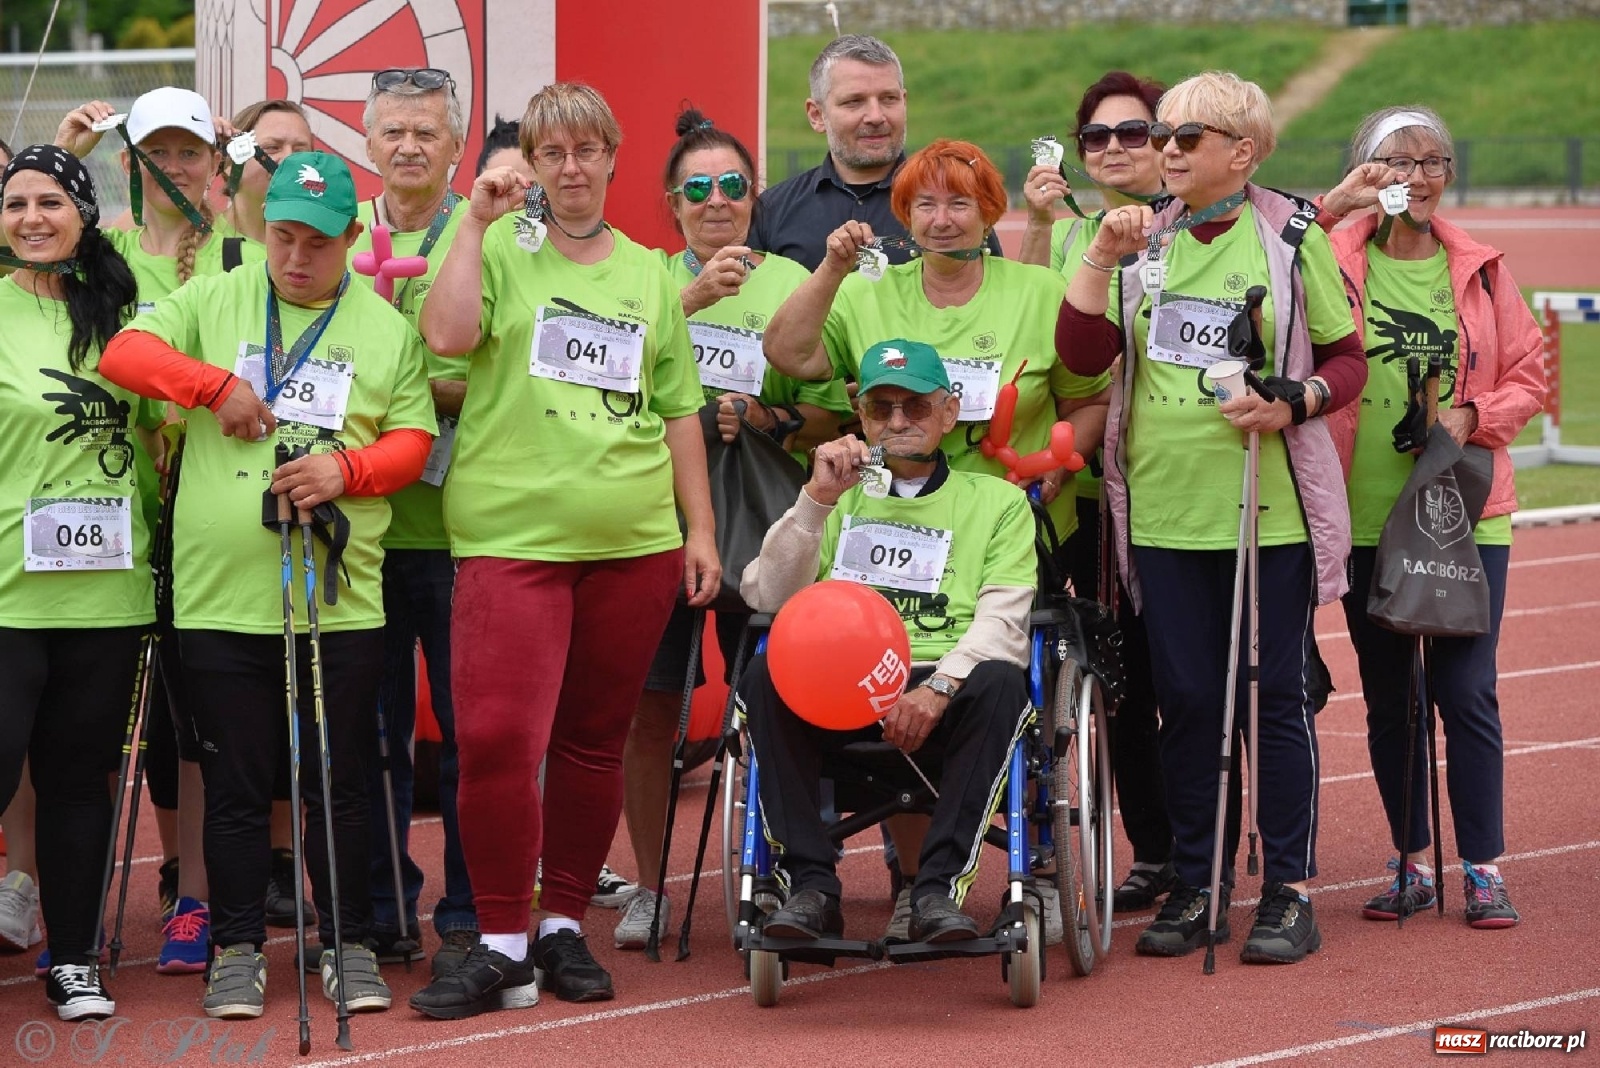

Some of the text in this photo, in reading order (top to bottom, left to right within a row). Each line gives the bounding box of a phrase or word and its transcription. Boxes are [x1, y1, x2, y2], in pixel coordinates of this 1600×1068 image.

[1179, 321, 1227, 349] 062
[1402, 331, 1428, 345] VII
[566, 337, 607, 366] 041
[692, 344, 736, 369] 070
[280, 377, 315, 402] 58
[80, 401, 106, 418] VII
[56, 524, 103, 547] 068
[870, 544, 913, 569] 019
[1403, 558, 1480, 583] RACIBÓRZ
[894, 597, 921, 613] VII
[857, 648, 899, 694] TEB
